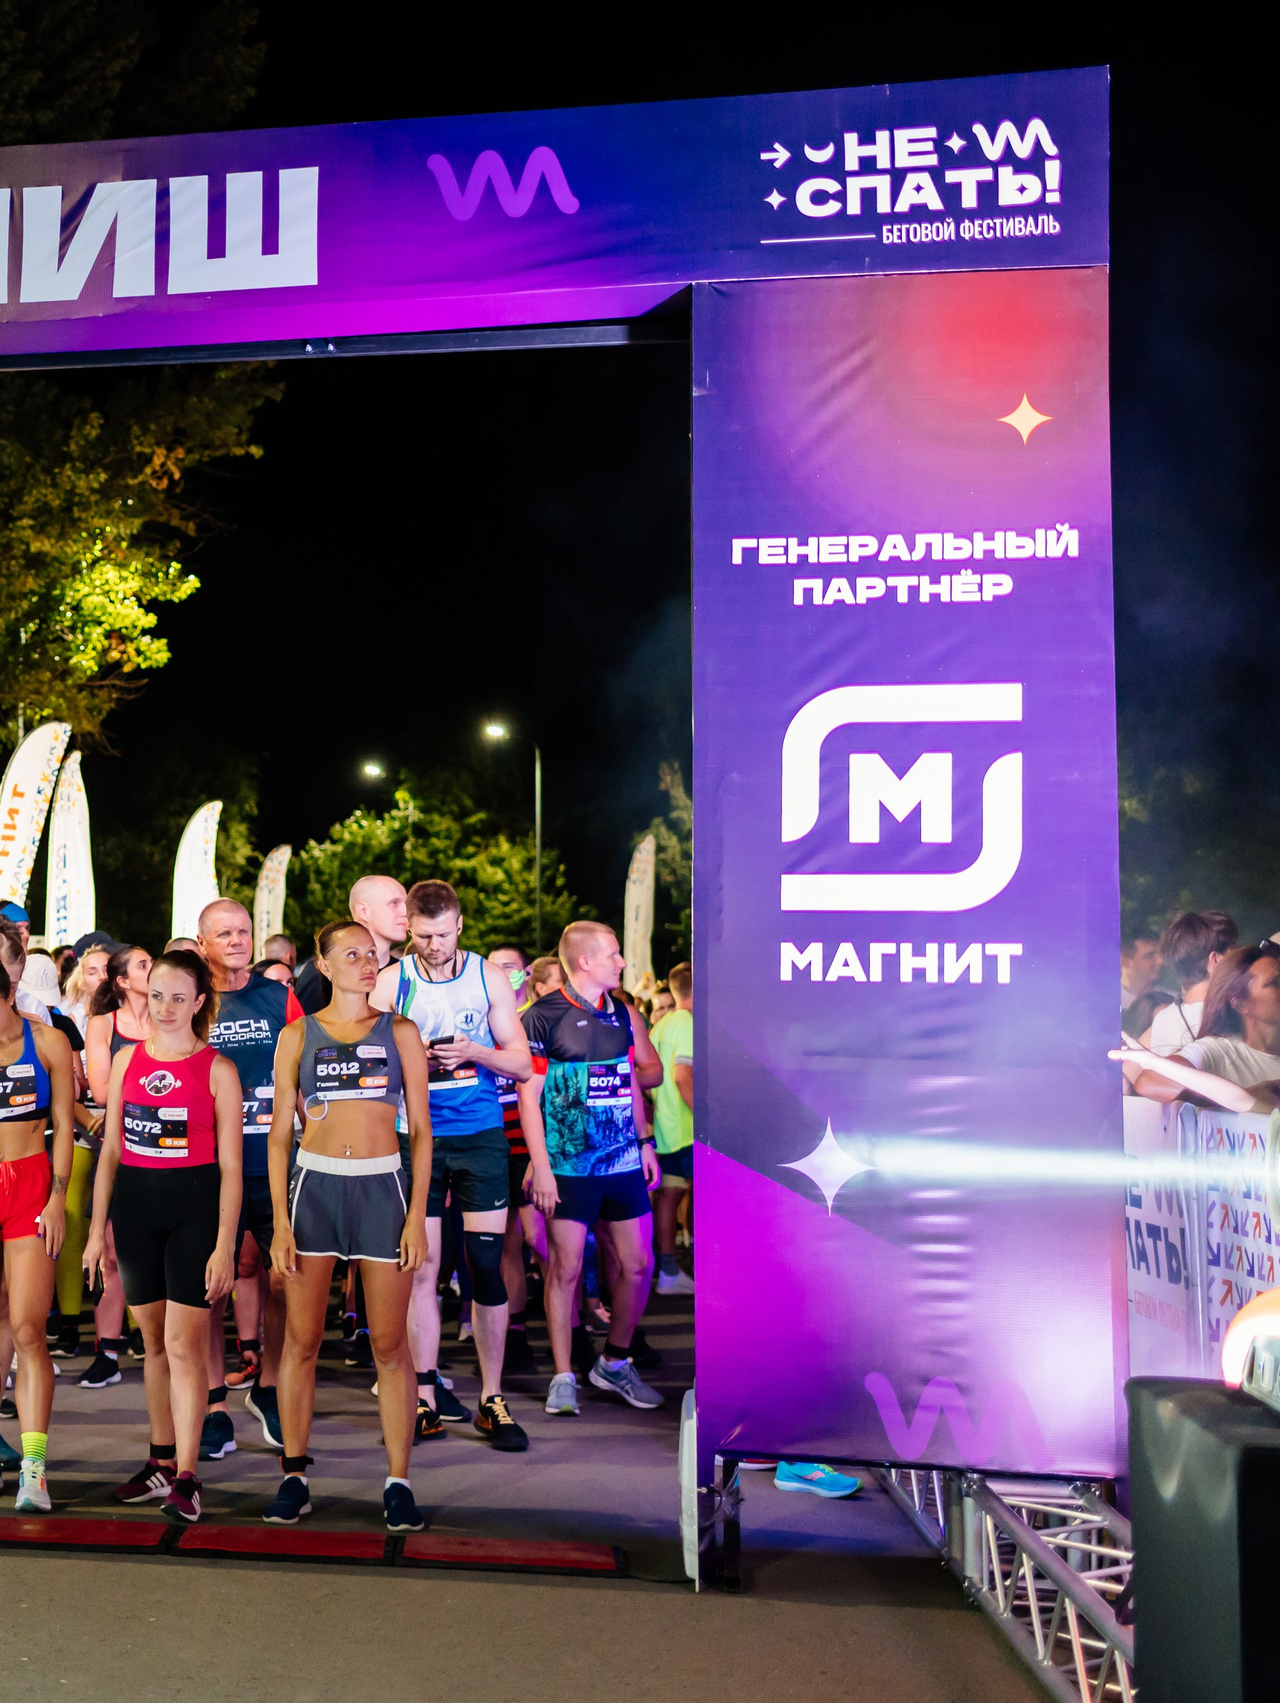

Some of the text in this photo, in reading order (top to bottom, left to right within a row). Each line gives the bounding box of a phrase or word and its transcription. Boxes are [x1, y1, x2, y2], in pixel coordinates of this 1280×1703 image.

[843, 126, 938, 171] НЕ
[795, 159, 1061, 218] СПАТЬ!
[882, 214, 1060, 244] БЕГОВОЙ ФЕСТИВАЛЬ
[731, 522, 1079, 565] ГЕНЕРАЛЬНЫЙ
[793, 569, 1014, 606] ПАРТНЁР
[780, 942, 1023, 984] МАГНИТ
[207, 1031, 272, 1043] AUTODROM
[209, 1019, 270, 1036] SOCHI
[316, 1061, 360, 1077] 5012
[589, 1076, 621, 1087] 5074
[124, 1116, 162, 1134] 5072
